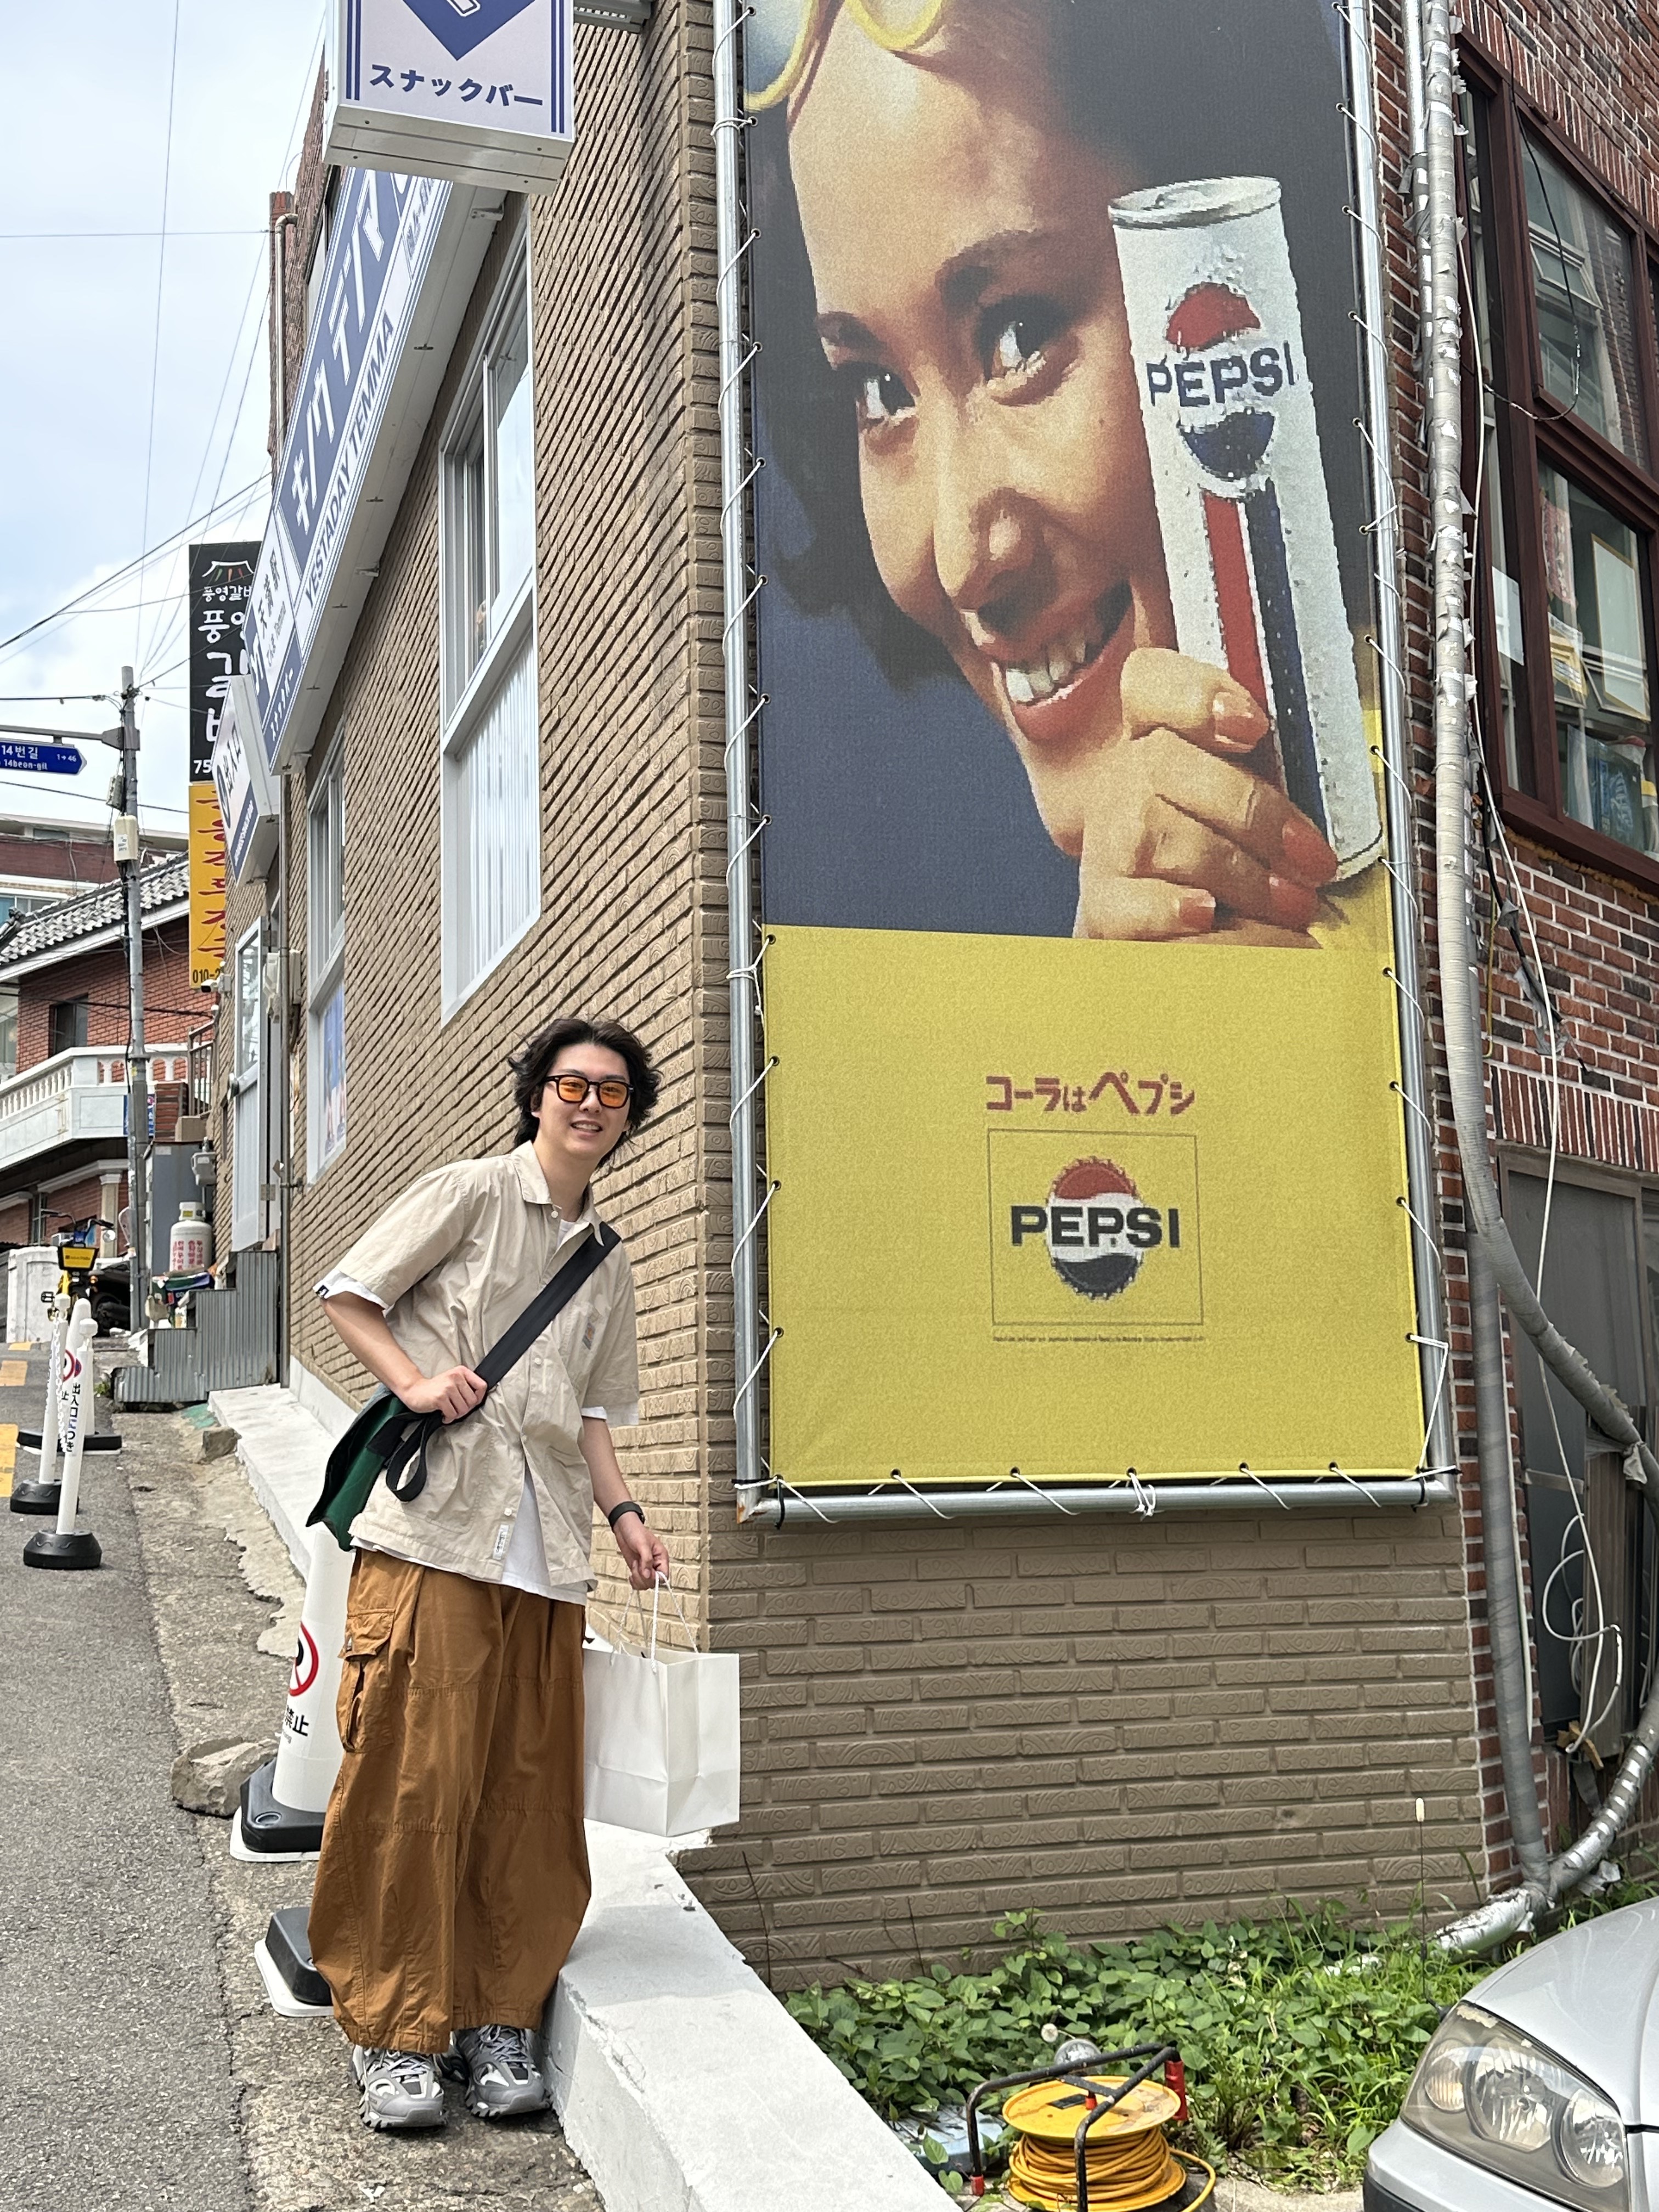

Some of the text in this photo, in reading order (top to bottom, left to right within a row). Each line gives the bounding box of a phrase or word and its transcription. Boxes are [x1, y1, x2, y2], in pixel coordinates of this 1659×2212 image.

[370, 64, 543, 106] スナックバー
[1147, 340, 1294, 407] PEPSI
[306, 309, 394, 608] YESTADAY TEMMA
[1, 745, 38, 760] 14번길
[986, 1070, 1195, 1115] コーラはペプシ
[1011, 1205, 1181, 1248] PEPSI
